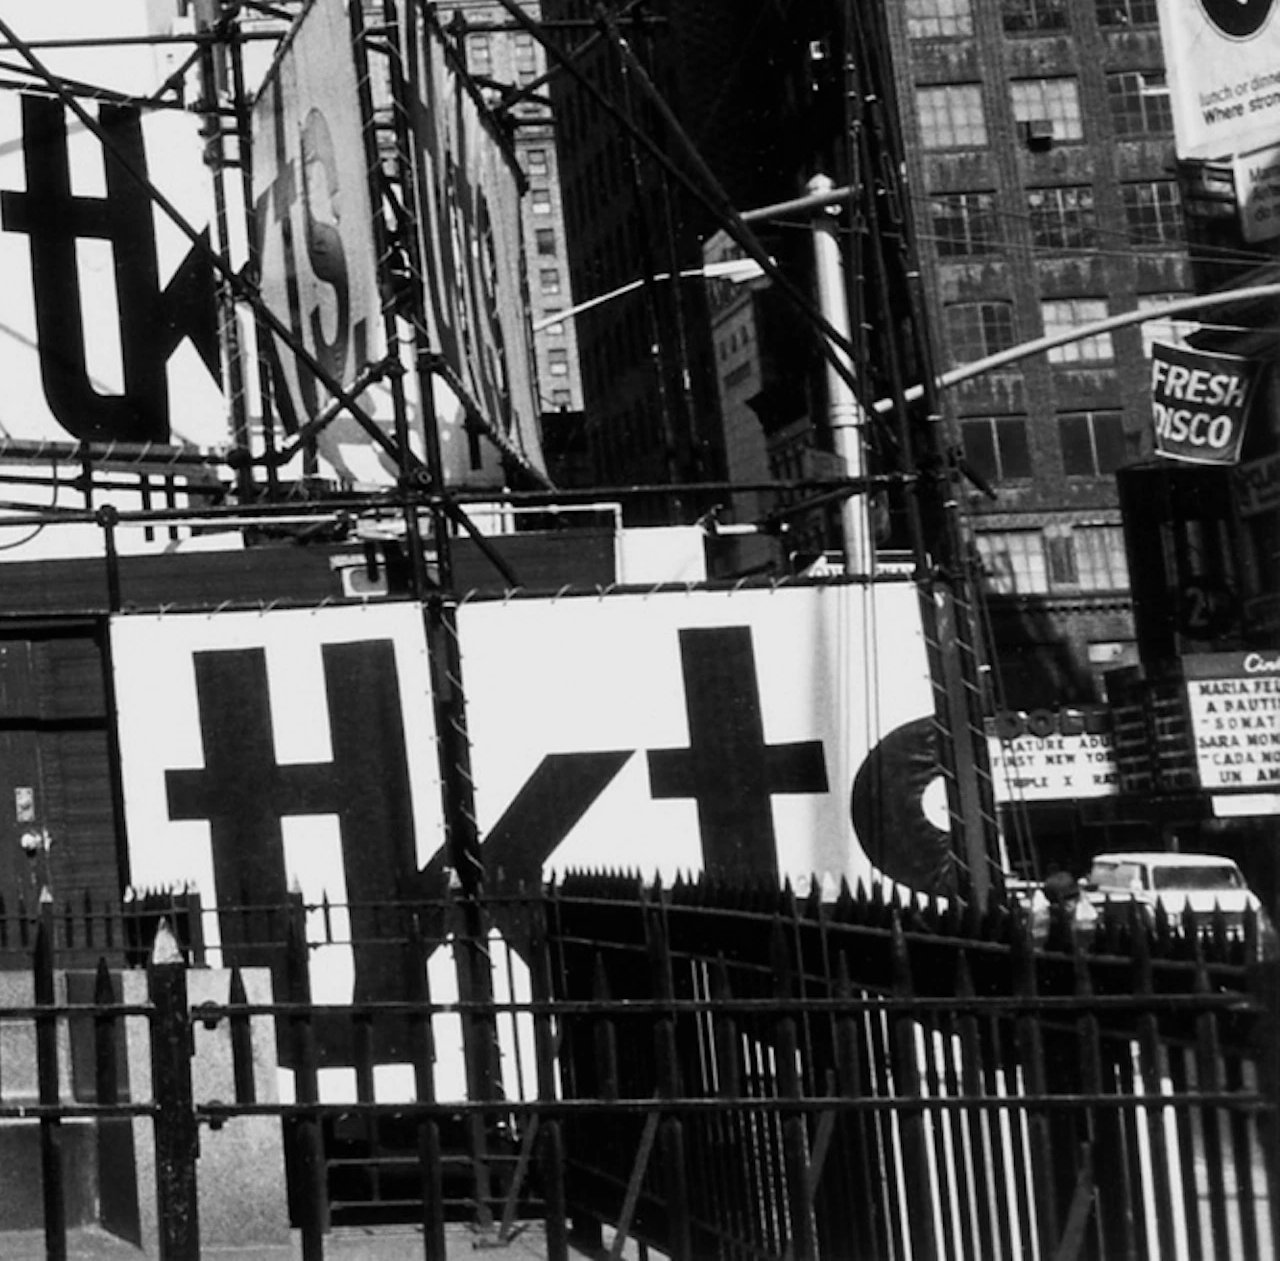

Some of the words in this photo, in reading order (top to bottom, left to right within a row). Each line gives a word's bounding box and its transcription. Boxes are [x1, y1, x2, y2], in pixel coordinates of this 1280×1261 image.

[1235, 81, 1249, 96] or
[1202, 103, 1244, 126] Where
[1152, 359, 1249, 408] FRESH
[1154, 402, 1233, 449] DISCO
[1199, 681, 1249, 696] MARIA
[1198, 734, 1240, 749] SARA
[1045, 754, 1075, 765] NEW
[1219, 771, 1242, 784] UN
